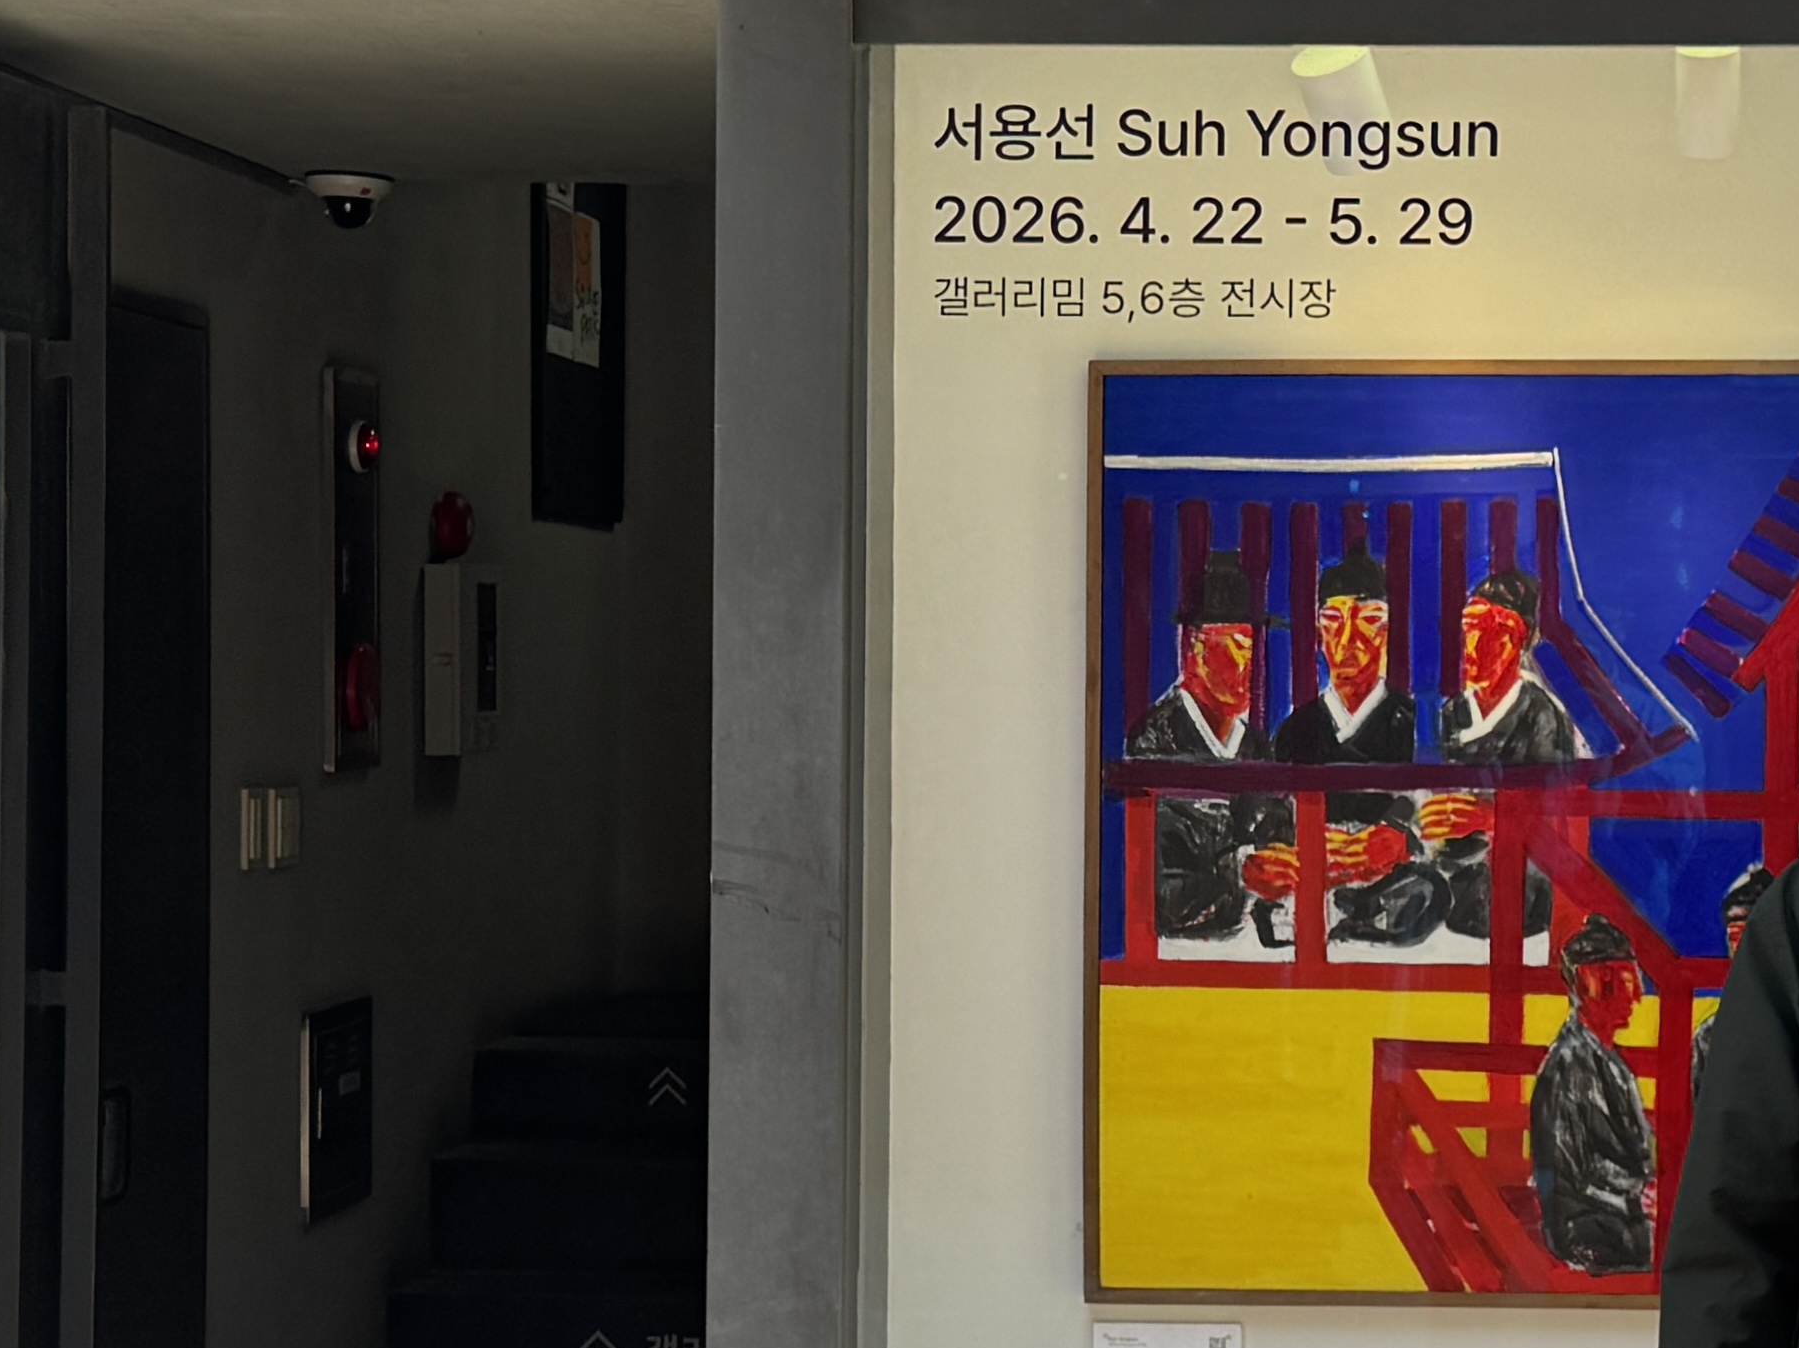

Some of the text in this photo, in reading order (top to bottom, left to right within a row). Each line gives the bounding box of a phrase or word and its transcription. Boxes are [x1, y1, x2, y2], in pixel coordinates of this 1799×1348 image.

[933, 103, 1500, 171] 서용선 Suh Yongsun
[933, 196, 1100, 245] 2026.
[1119, 196, 1172, 245] 4.
[1191, 196, 1264, 245] 22
[1328, 197, 1379, 245] 5.
[1398, 197, 1473, 246] 29
[933, 276, 1338, 323] 갤러리밈 5,6층 전시장
